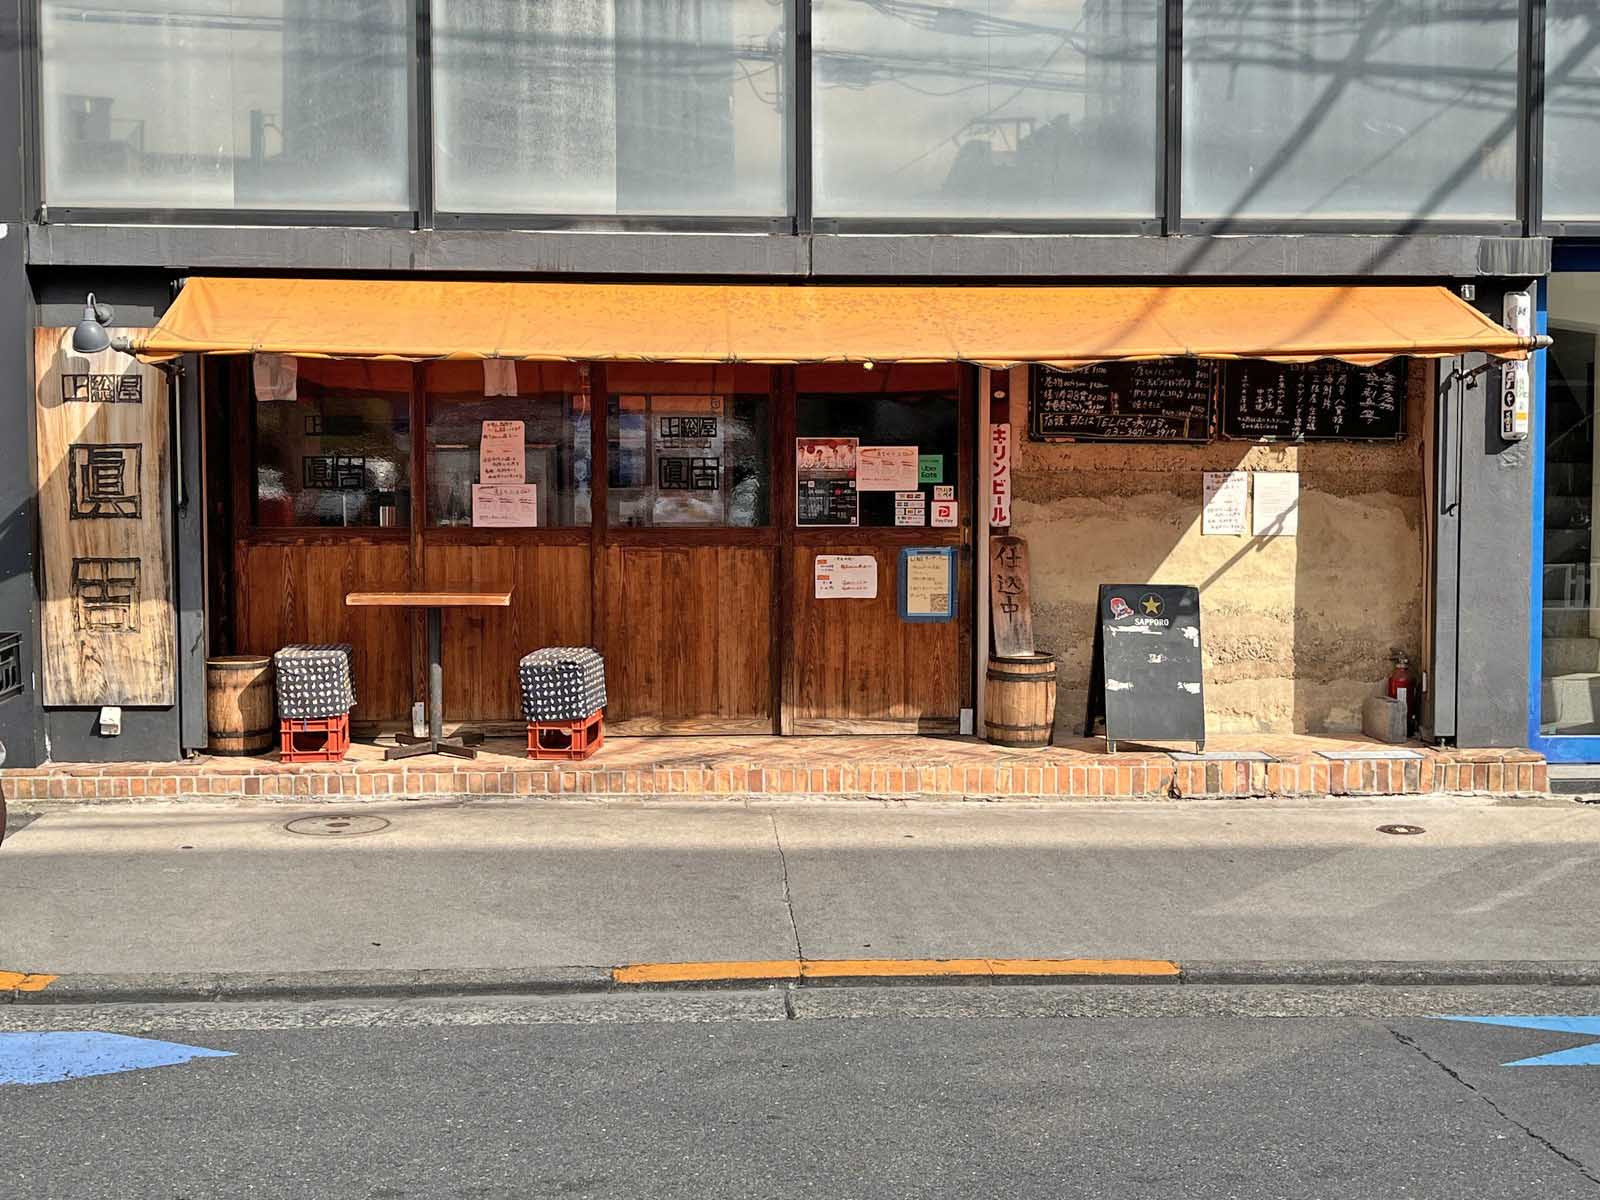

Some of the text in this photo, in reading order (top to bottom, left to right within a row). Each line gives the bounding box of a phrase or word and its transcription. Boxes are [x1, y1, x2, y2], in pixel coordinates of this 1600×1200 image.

[992, 428, 1007, 522] キリンビール
[995, 546, 1023, 624] 仕込中
[1134, 618, 1169, 626] SAPPORO
